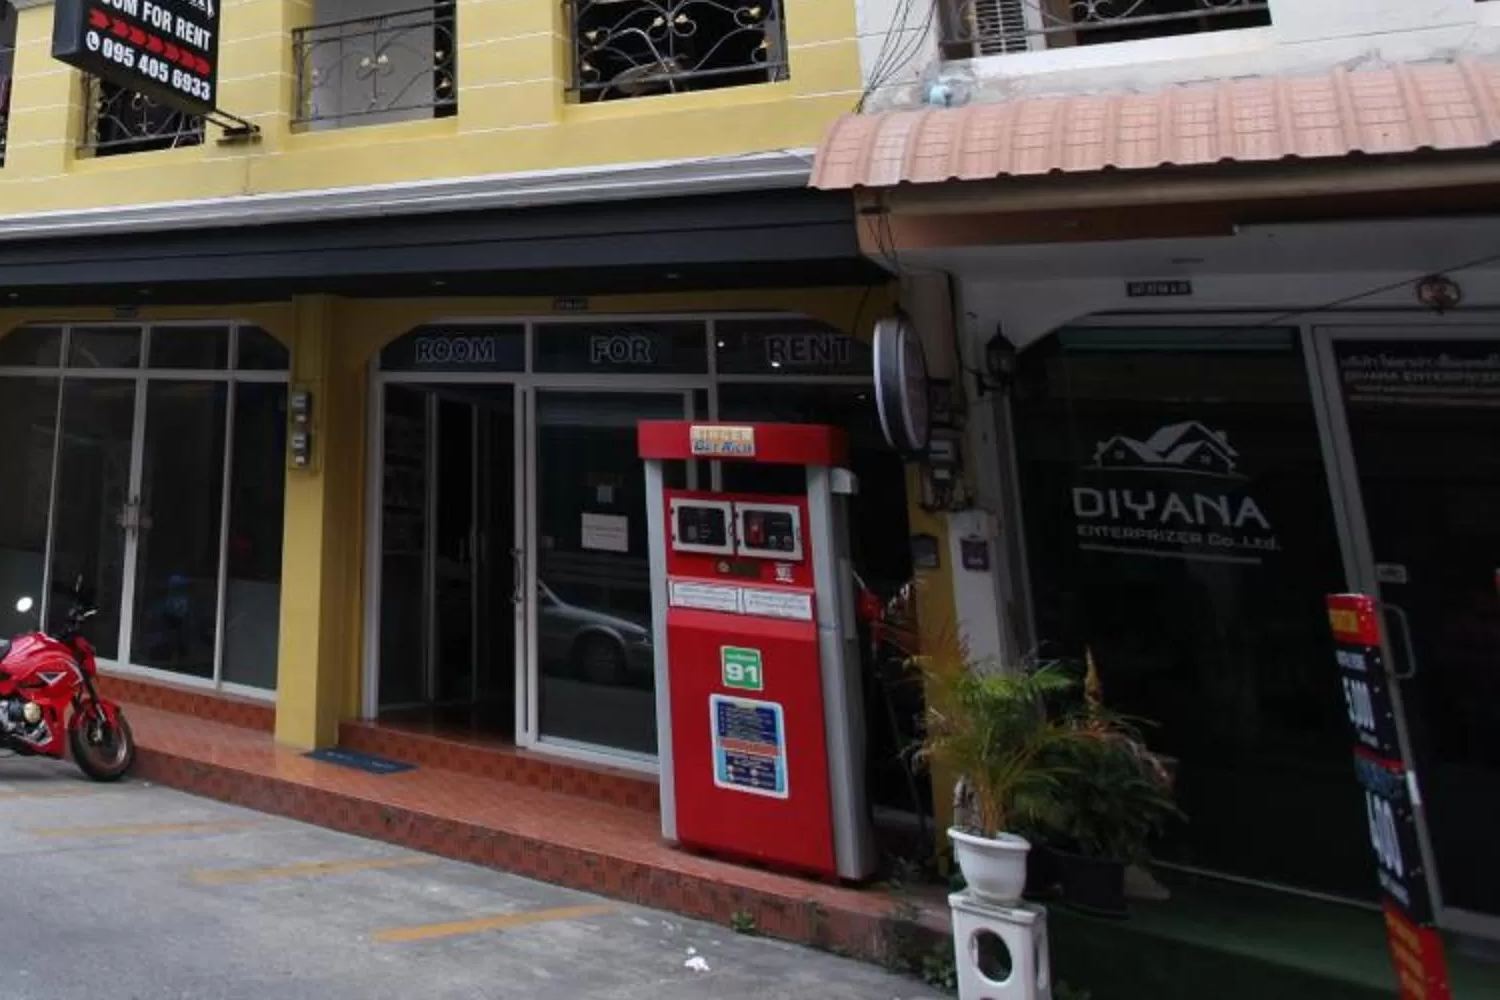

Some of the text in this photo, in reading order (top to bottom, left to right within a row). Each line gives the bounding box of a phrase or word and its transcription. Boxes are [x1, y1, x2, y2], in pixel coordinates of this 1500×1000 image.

[143, 0, 172, 34] FOR
[175, 17, 213, 52] RENT
[103, 38, 211, 101] 095 405 6933
[414, 334, 853, 366] ROOM FOR RENT
[1072, 487, 1270, 529] DIYANA
[726, 662, 758, 683] 91
